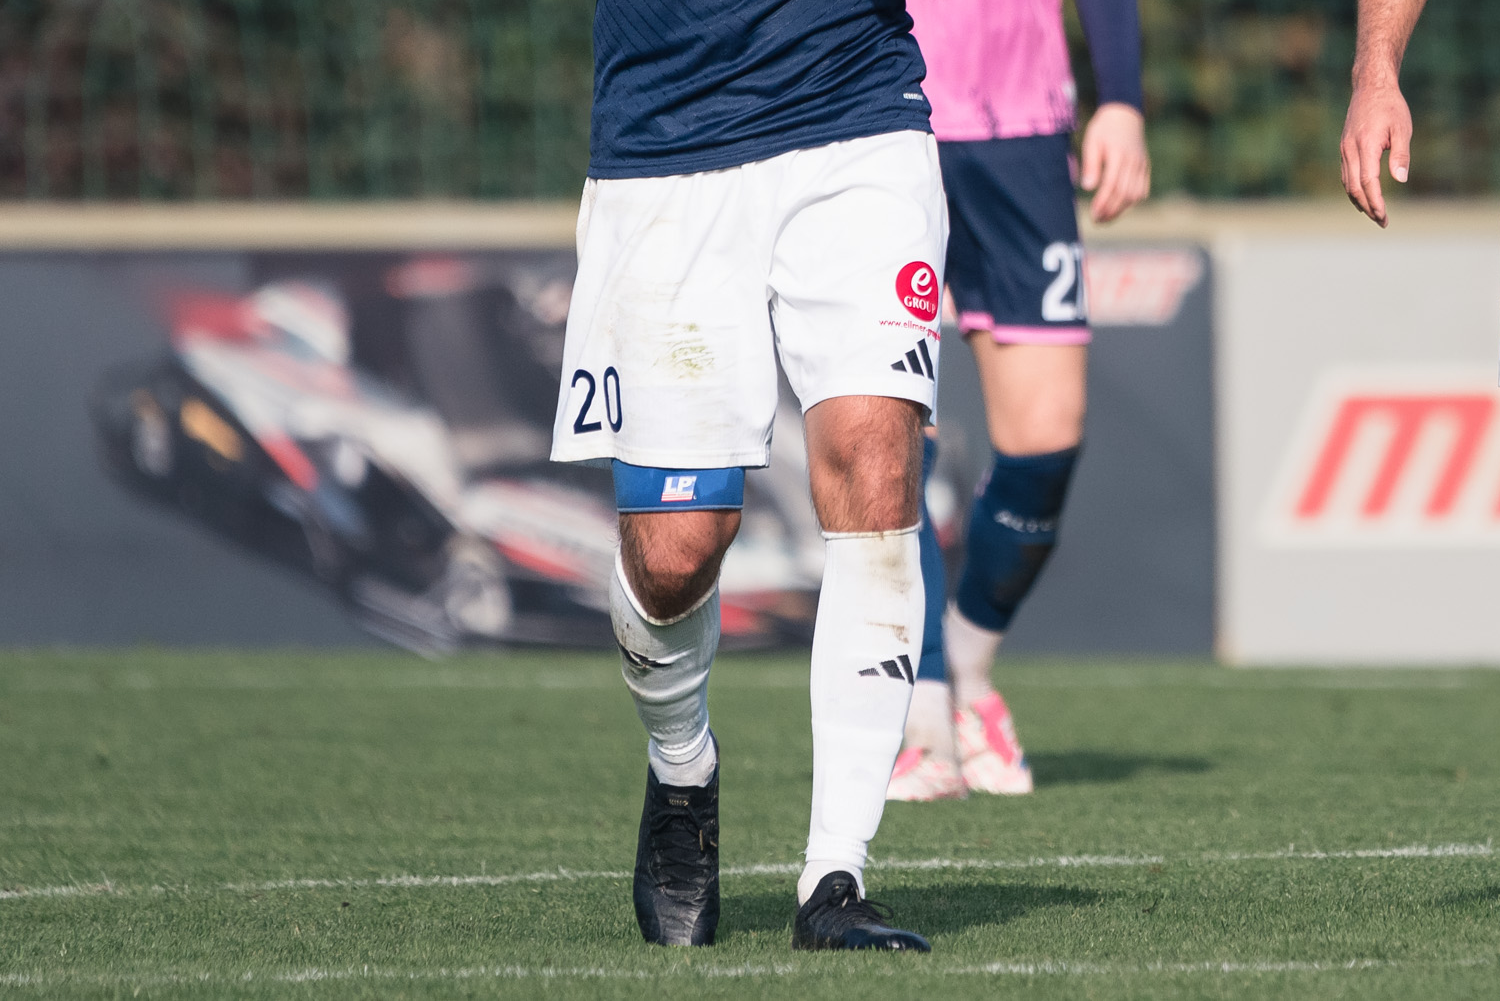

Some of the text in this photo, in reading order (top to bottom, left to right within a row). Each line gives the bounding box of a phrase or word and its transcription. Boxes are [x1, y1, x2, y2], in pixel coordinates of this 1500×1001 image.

[903, 296, 936, 314] GROUP
[571, 366, 622, 434] 20
[664, 476, 693, 493] LP
